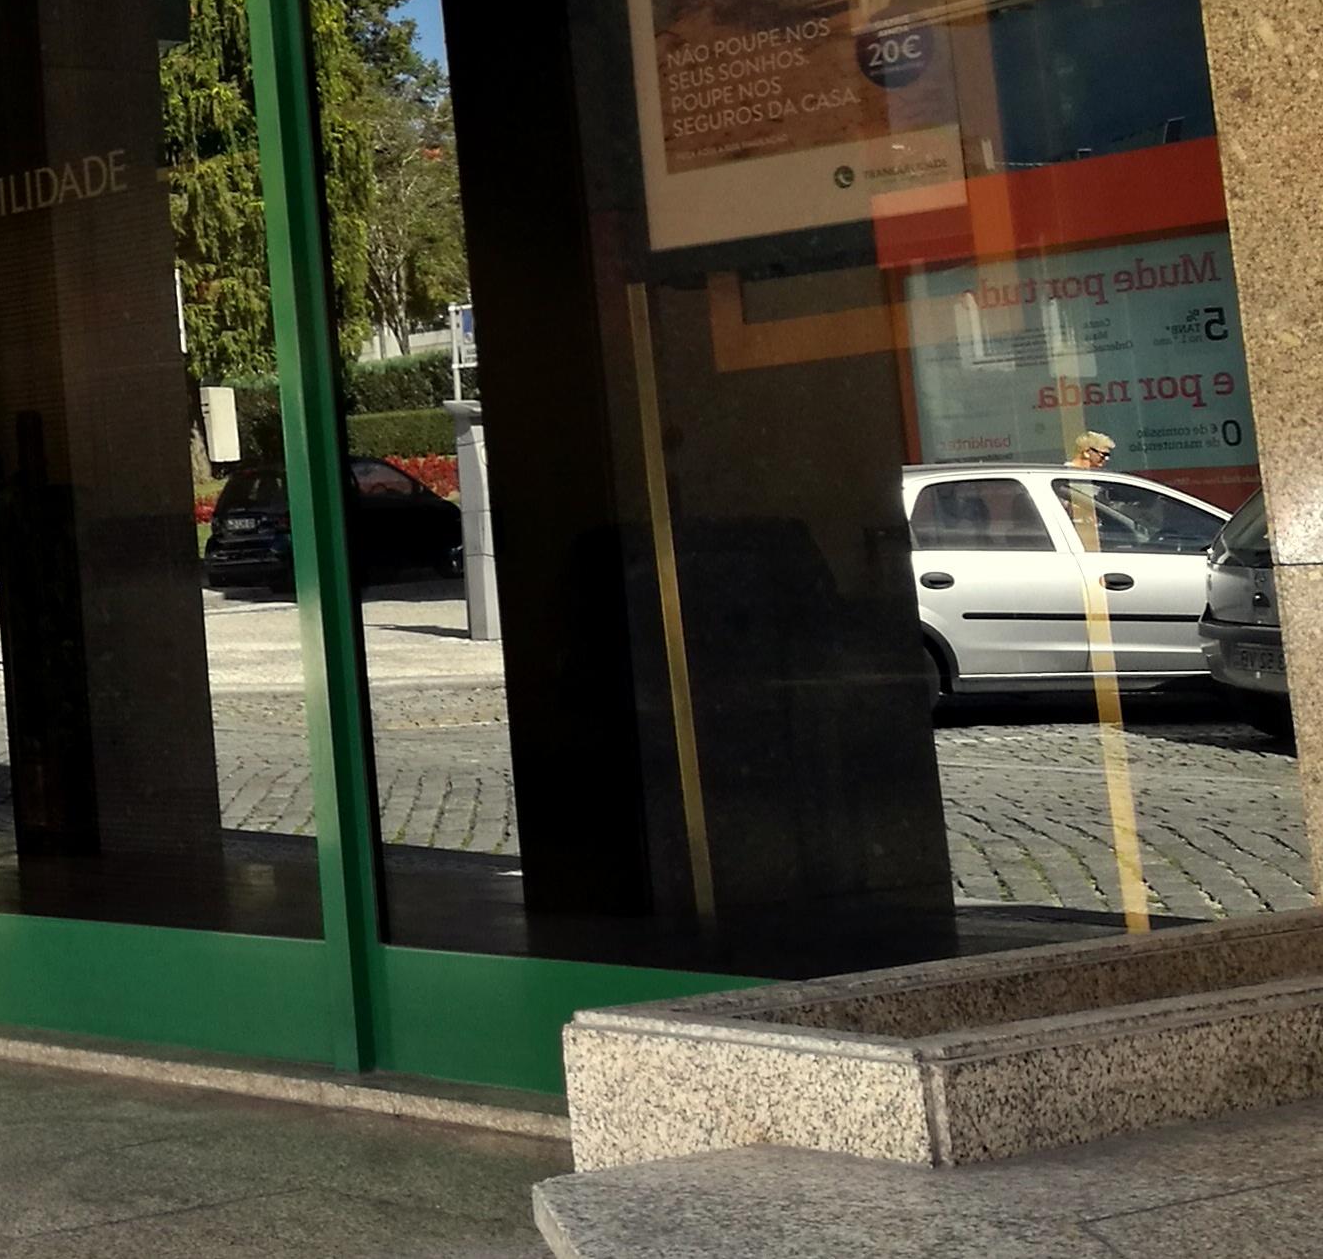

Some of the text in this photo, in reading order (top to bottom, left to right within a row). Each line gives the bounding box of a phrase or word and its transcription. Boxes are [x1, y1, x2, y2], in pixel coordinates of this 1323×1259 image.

[667, 17, 831, 69] NÃO POUPE NOS
[669, 48, 810, 92] SEUS SONHOS.
[671, 76, 783, 114] POUPE NOS
[673, 87, 861, 138] SEGUROS DA CASA.
